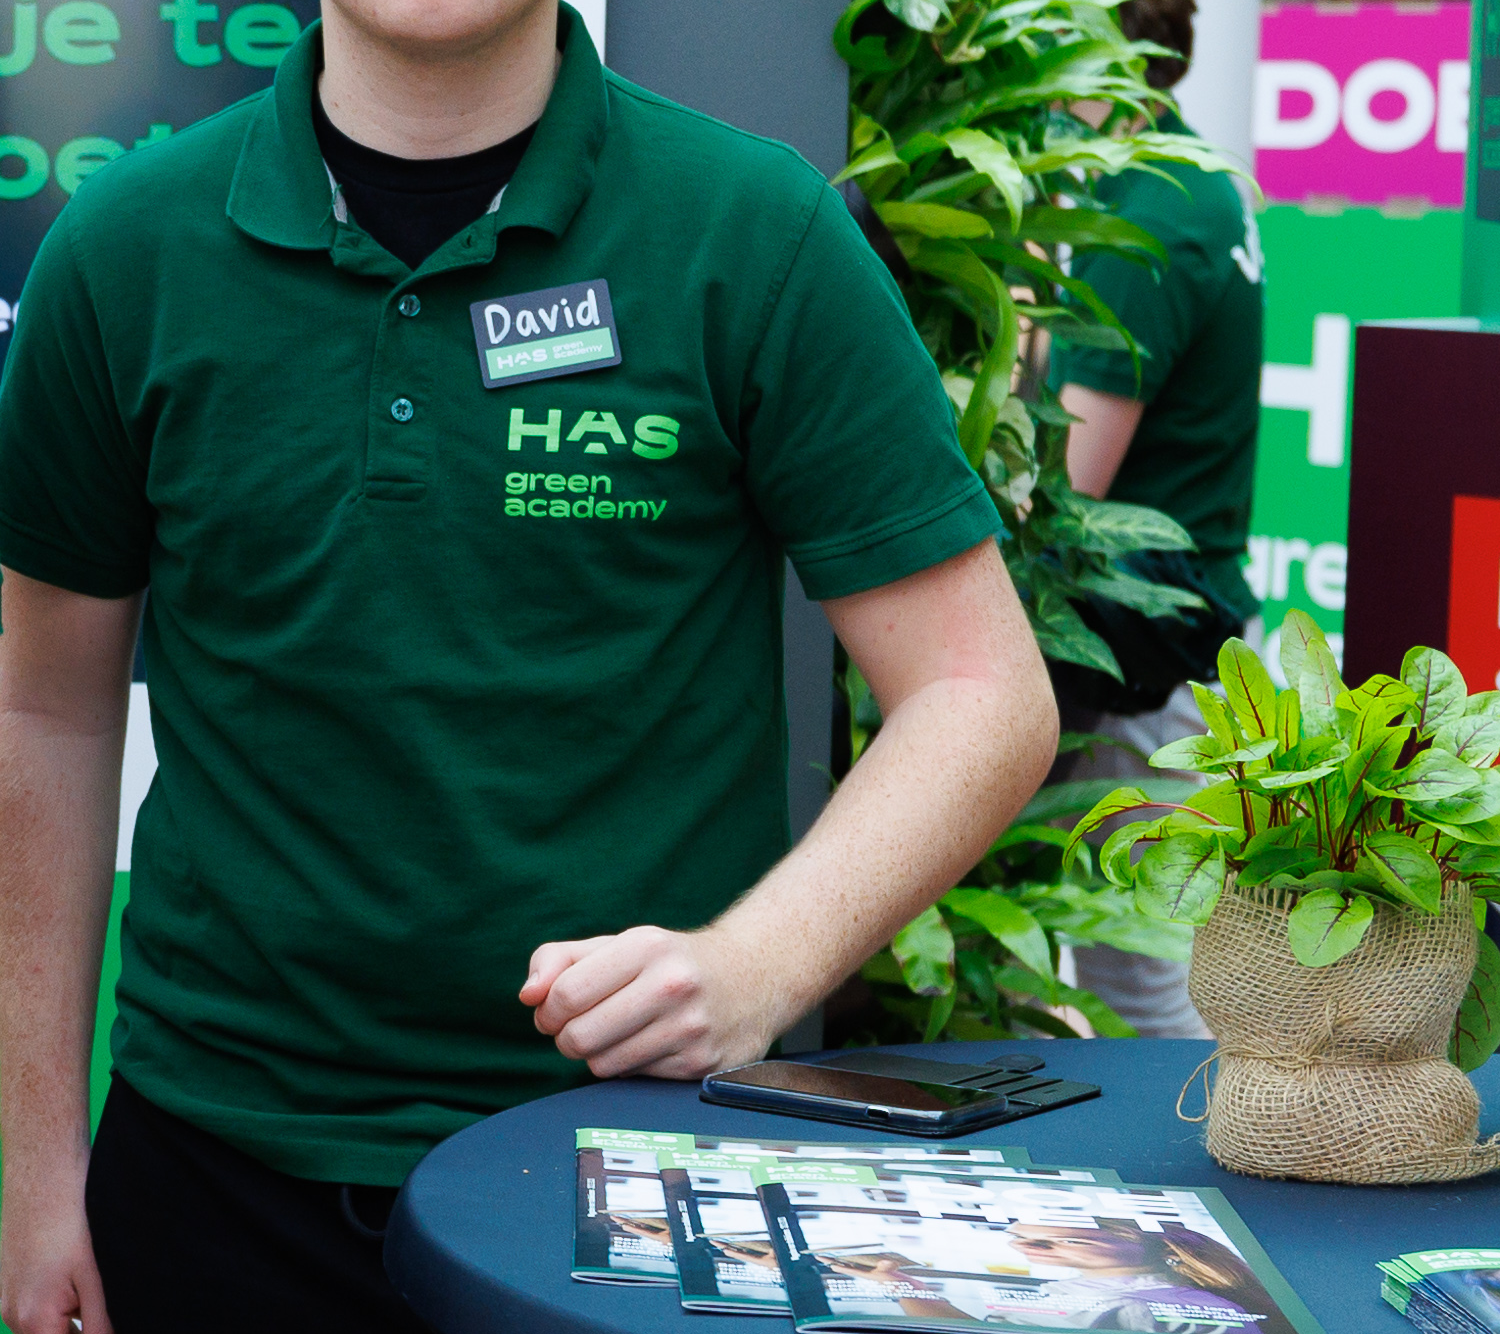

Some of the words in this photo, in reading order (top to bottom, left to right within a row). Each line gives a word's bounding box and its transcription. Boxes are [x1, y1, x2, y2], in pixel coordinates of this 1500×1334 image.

[484, 288, 601, 345] David
[496, 348, 549, 370] HAS
[552, 340, 584, 353] green
[553, 344, 603, 359] academy
[507, 408, 681, 460] HAS
[504, 471, 612, 495] green
[504, 495, 668, 521] academy
